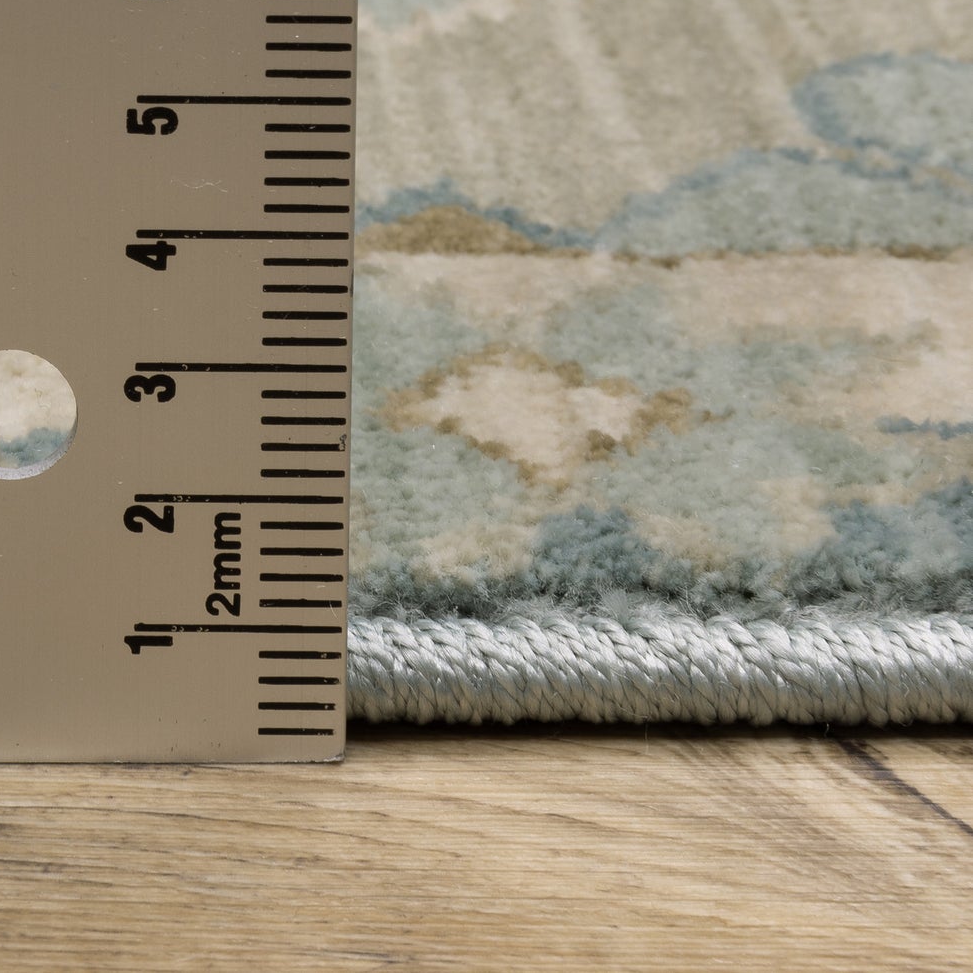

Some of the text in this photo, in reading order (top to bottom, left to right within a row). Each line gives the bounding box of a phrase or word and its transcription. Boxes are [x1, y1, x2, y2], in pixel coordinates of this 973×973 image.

[126, 107, 178, 135] 5
[125, 240, 177, 271] 4
[124, 374, 176, 403] 3
[123, 504, 175, 534] 2
[205, 512, 242, 617] 2mm
[123, 635, 173, 654] 1
